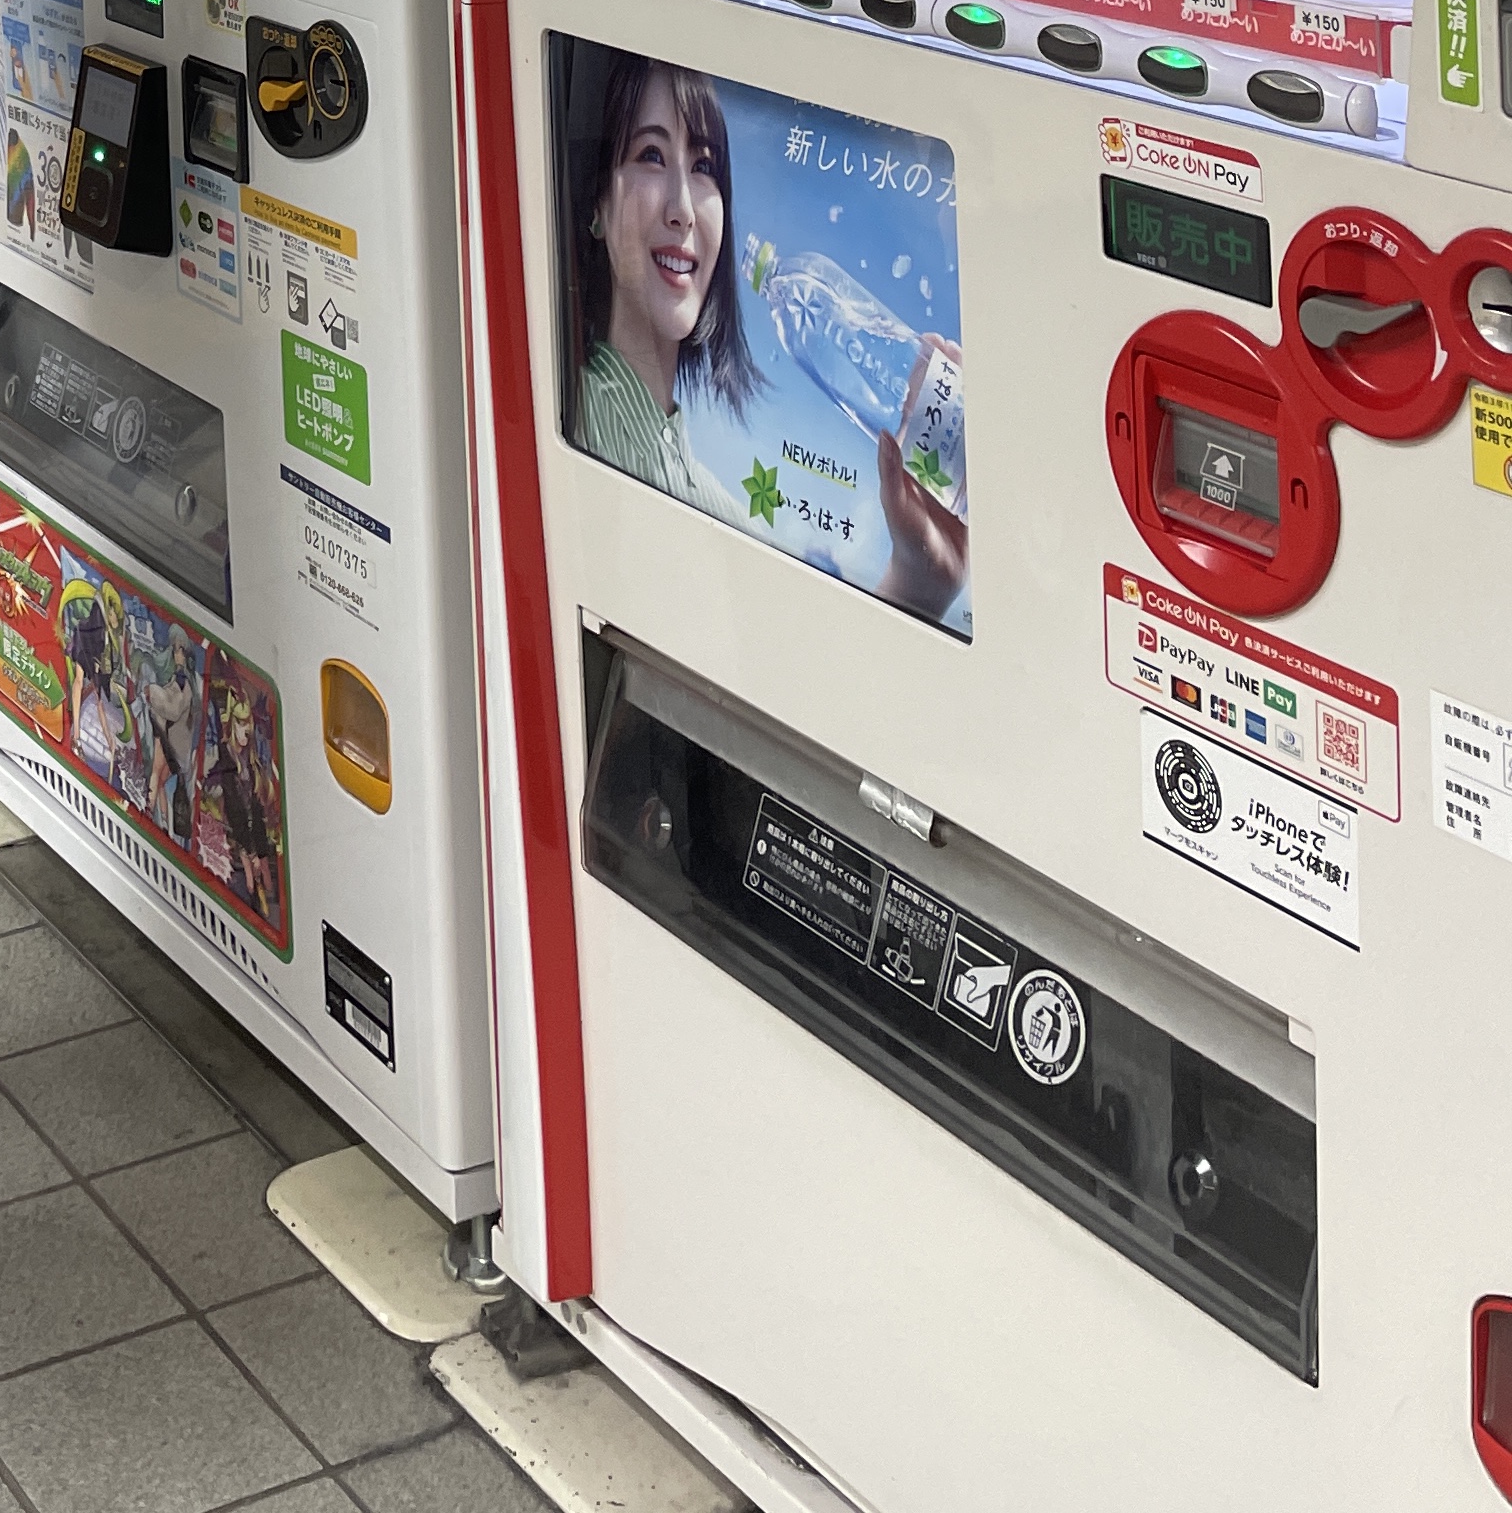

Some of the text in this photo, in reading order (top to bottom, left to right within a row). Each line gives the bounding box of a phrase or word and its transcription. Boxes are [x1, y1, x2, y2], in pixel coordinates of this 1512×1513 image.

[1136, 144, 1249, 193] Coke ON Pay
[1124, 198, 1254, 277] 販売中
[1323, 221, 1399, 257] おつり・返却
[294, 341, 353, 381] 地球にやさしい
[297, 412, 355, 452] ヒートポンプ
[782, 439, 857, 489] NEWボトル!
[1205, 484, 1231, 504] 1000
[304, 525, 367, 579] 02107375
[1146, 590, 1239, 647] Coke ON Pay
[1137, 665, 1161, 685] VISA
[1160, 636, 1215, 677] PayPay
[1225, 666, 1294, 712] LINE Pay
[1248, 798, 1326, 853] iPhoneで
[1329, 813, 1346, 830] Pay
[1231, 815, 1350, 891] タッチレス体験!
[1251, 863, 1331, 912] Touchless Experience
